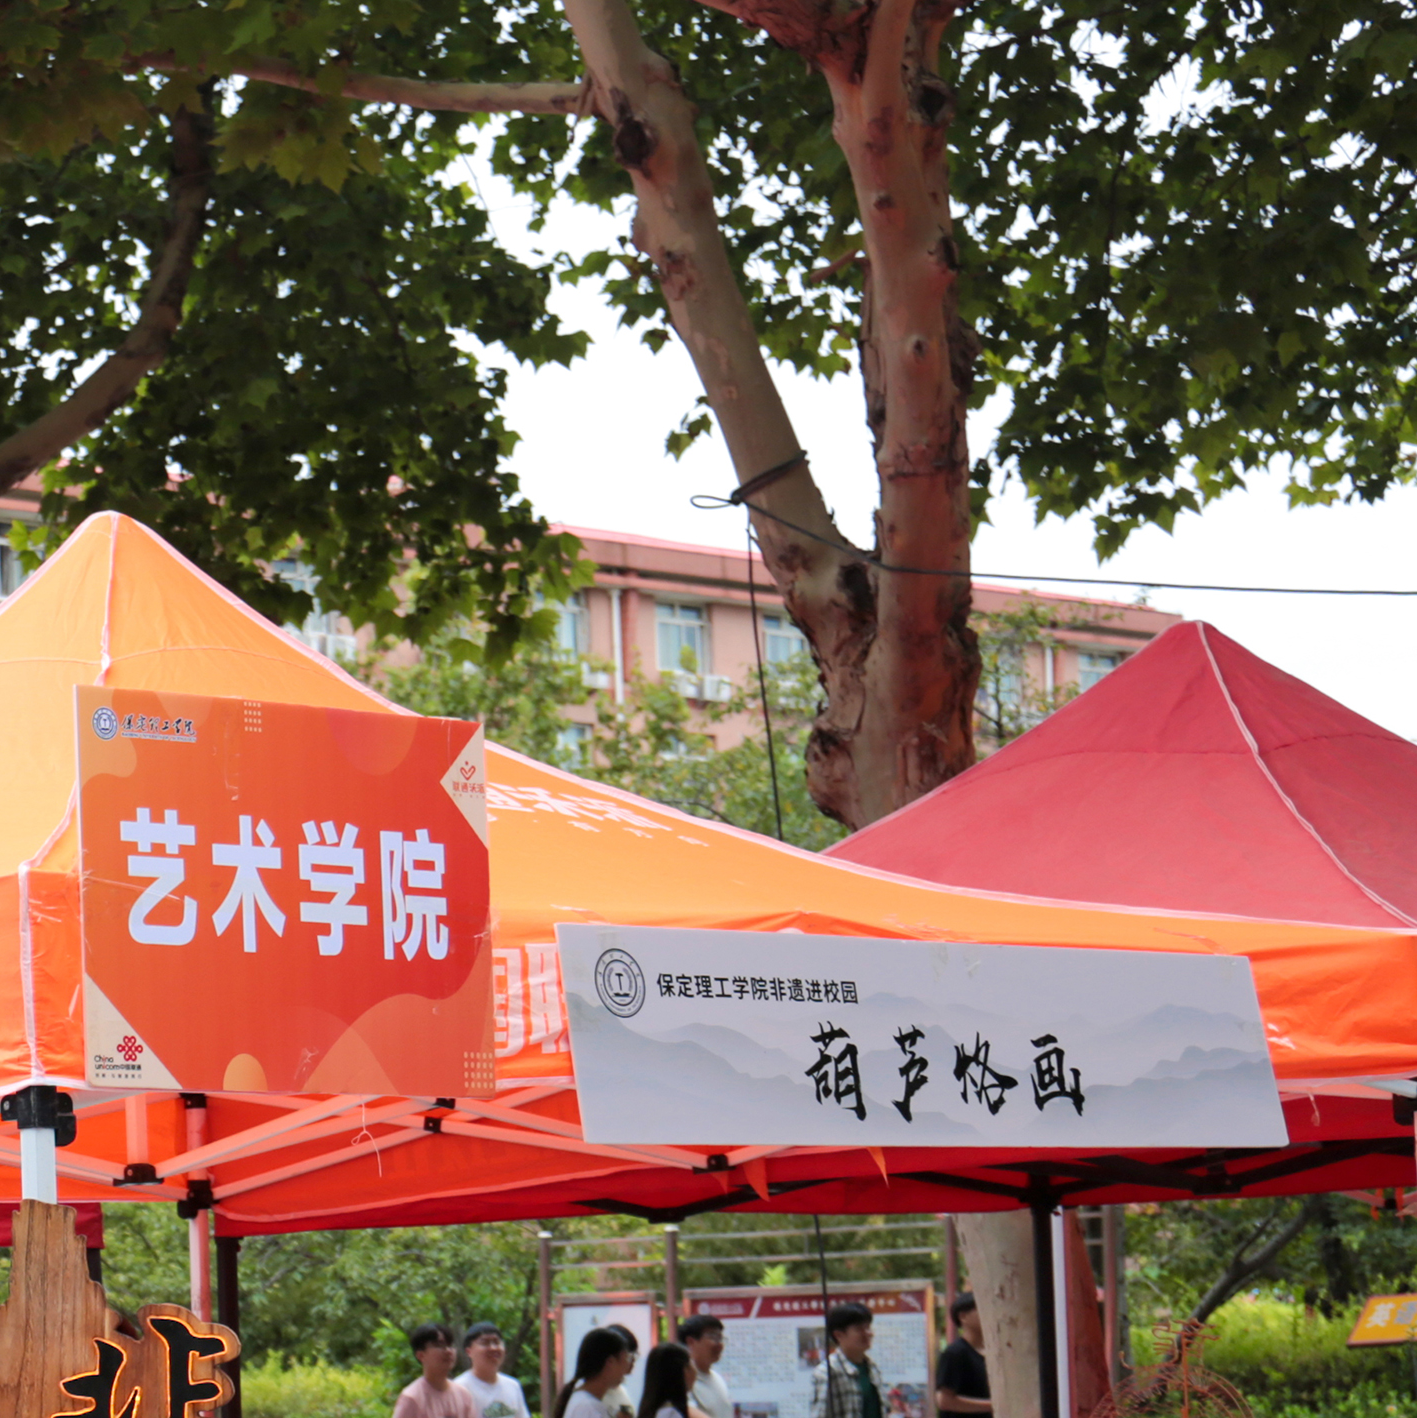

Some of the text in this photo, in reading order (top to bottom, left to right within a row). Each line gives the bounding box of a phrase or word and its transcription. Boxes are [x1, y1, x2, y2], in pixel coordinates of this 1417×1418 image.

[119, 807, 449, 961] 艺术学院
[656, 973, 859, 1005] 保定理工学院非遗进校园
[805, 1021, 1086, 1123] 葫芦烙画
